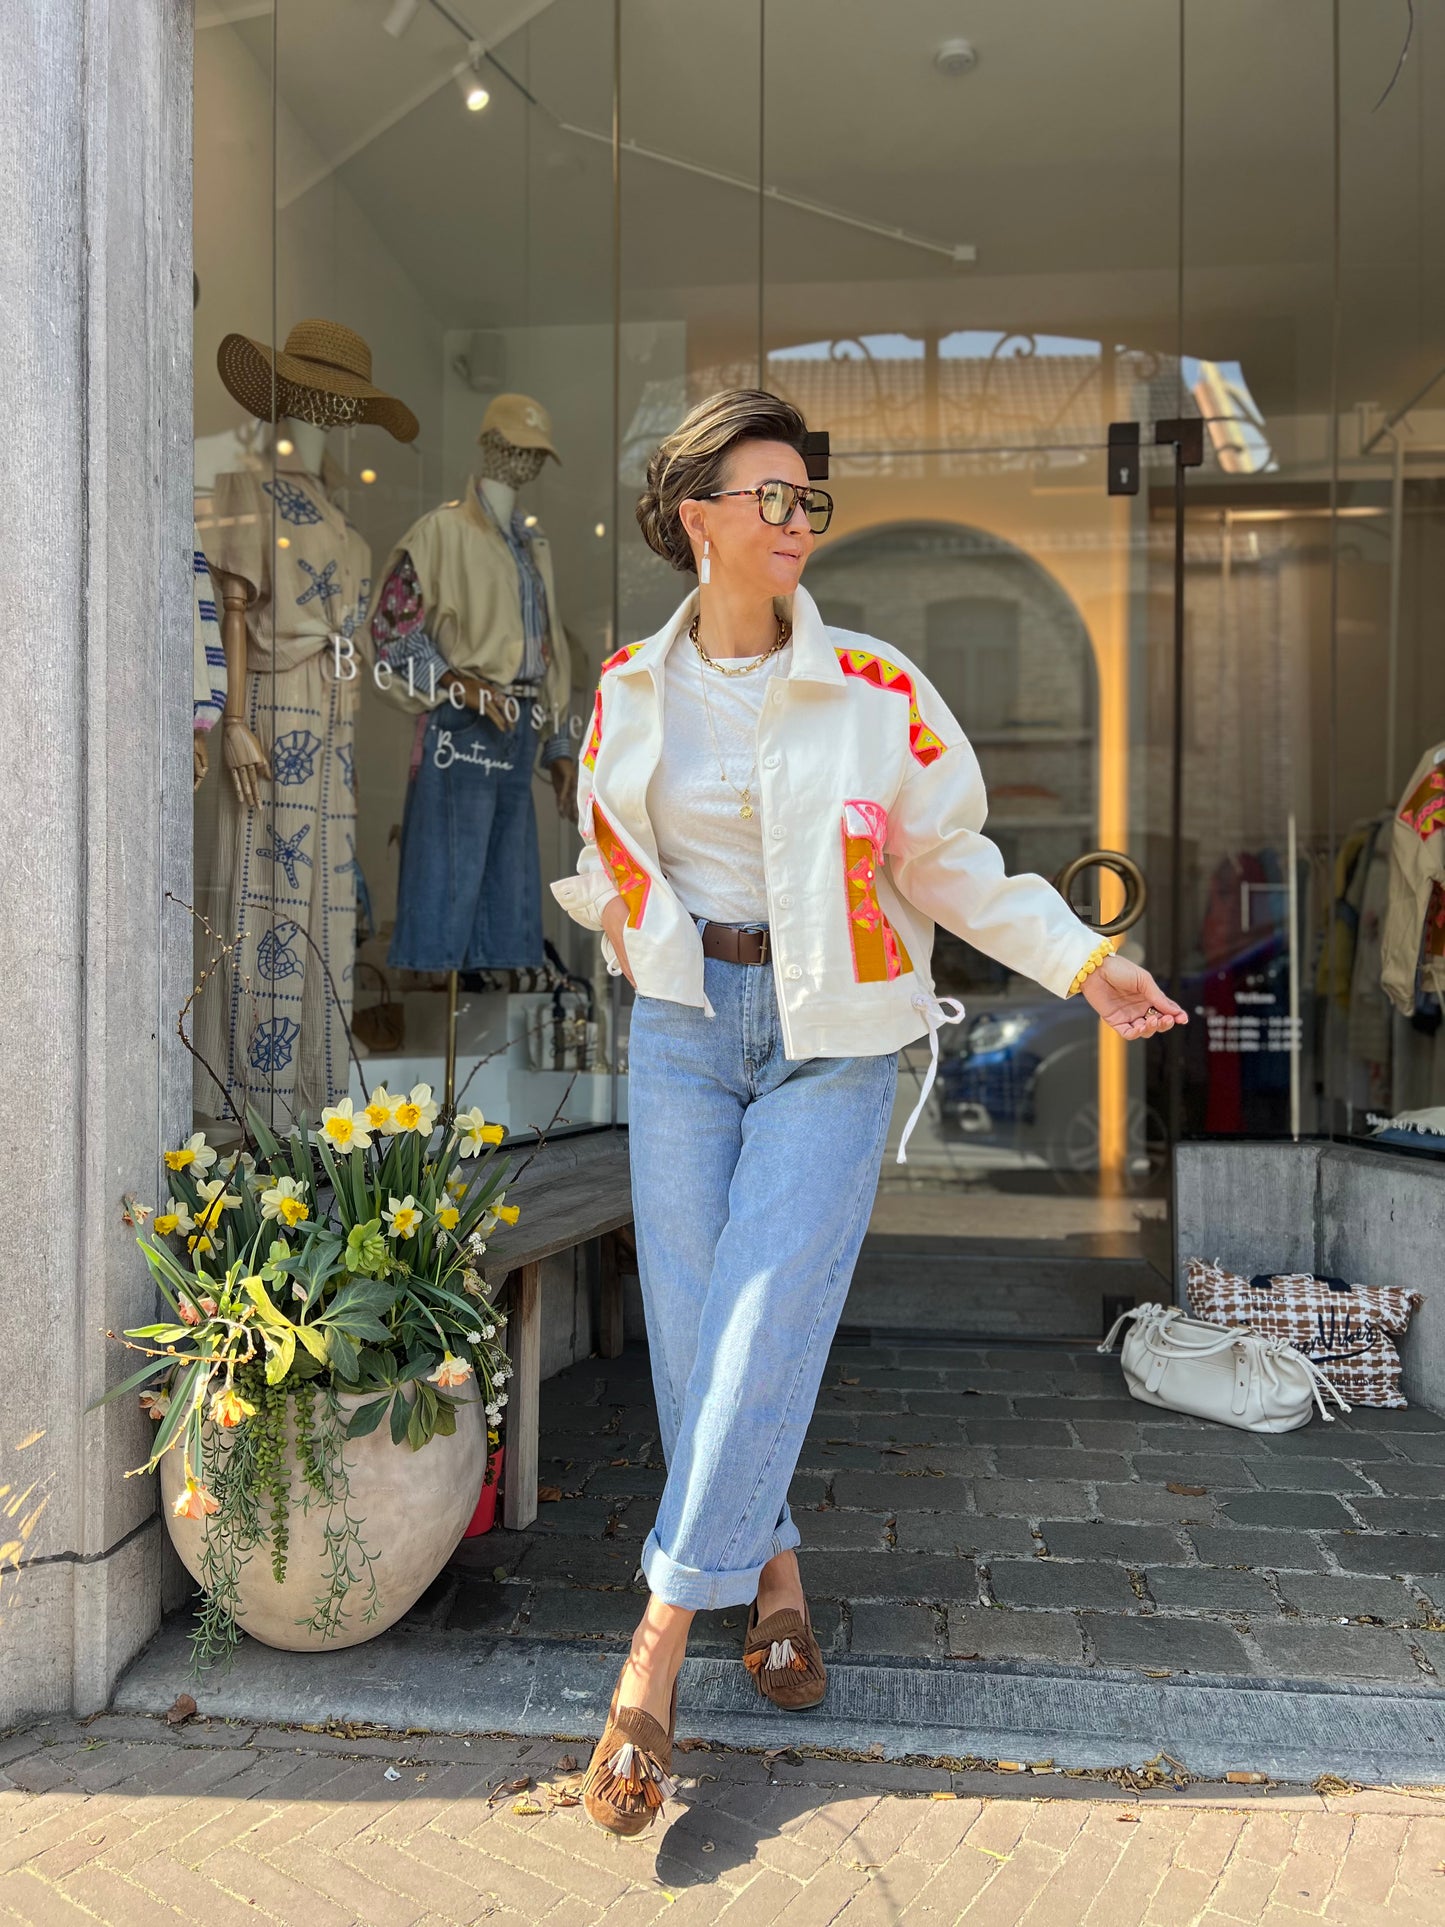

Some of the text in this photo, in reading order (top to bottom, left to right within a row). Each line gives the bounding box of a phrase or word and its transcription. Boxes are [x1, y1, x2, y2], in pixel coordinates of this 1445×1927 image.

[334, 635, 583, 739] Bellerosie
[433, 729, 514, 776] Boutique
[1366, 1112, 1389, 1130] Shop
[1392, 1118, 1413, 1132] 24/7
[1318, 1304, 1378, 1351] Vibes
